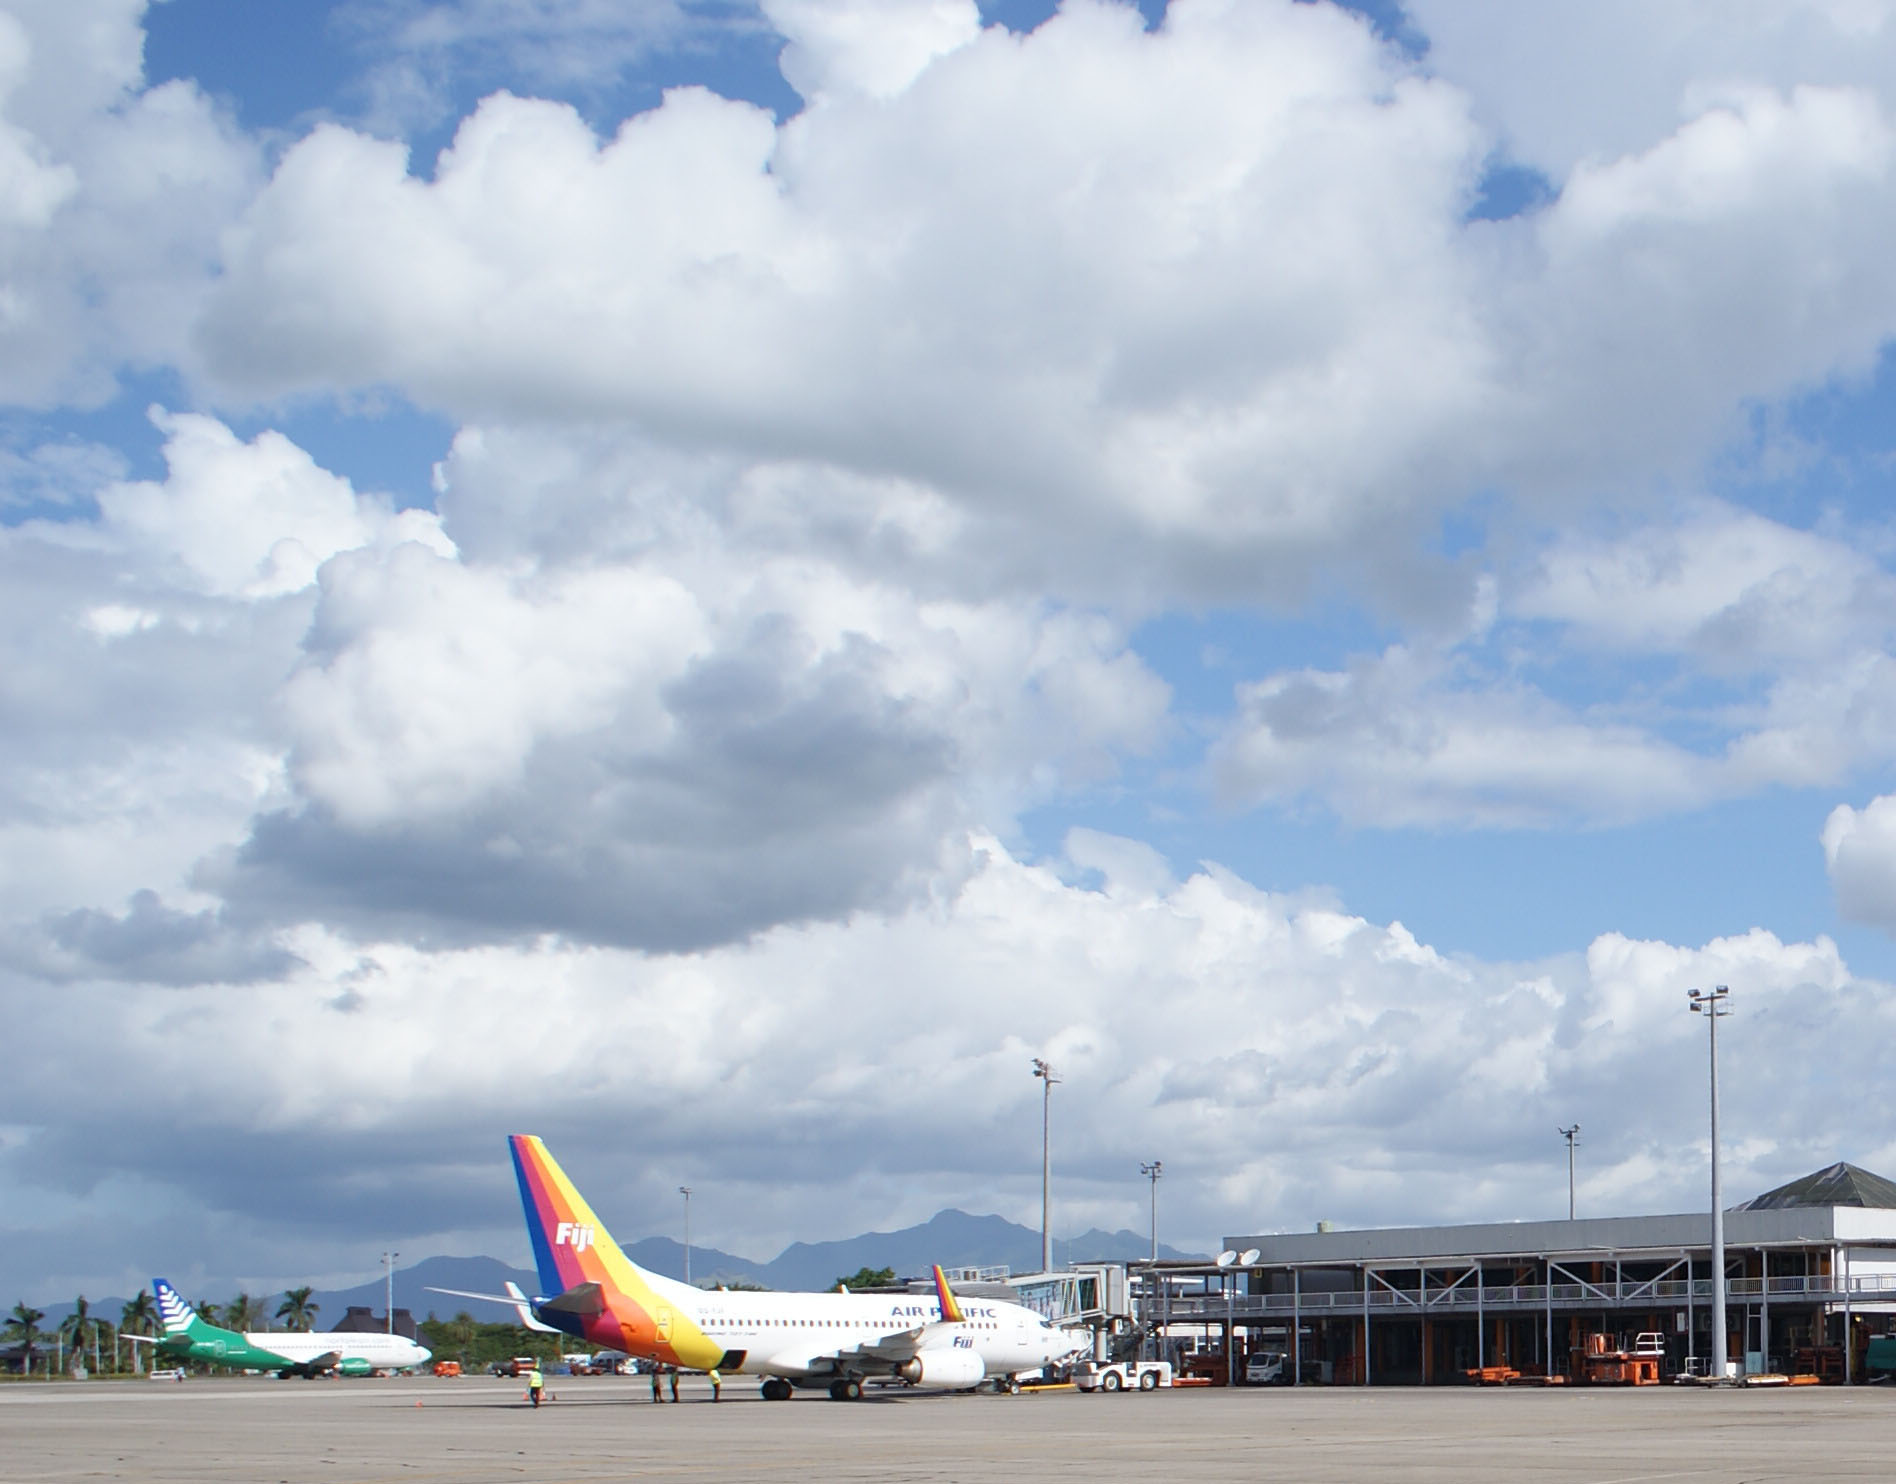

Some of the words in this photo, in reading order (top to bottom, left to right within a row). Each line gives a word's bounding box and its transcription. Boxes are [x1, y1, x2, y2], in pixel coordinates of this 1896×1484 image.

[555, 1222, 594, 1253] Fiji
[891, 1306, 926, 1317] AIR
[930, 1306, 997, 1318] PIFIC
[953, 1336, 973, 1349] Fiji
